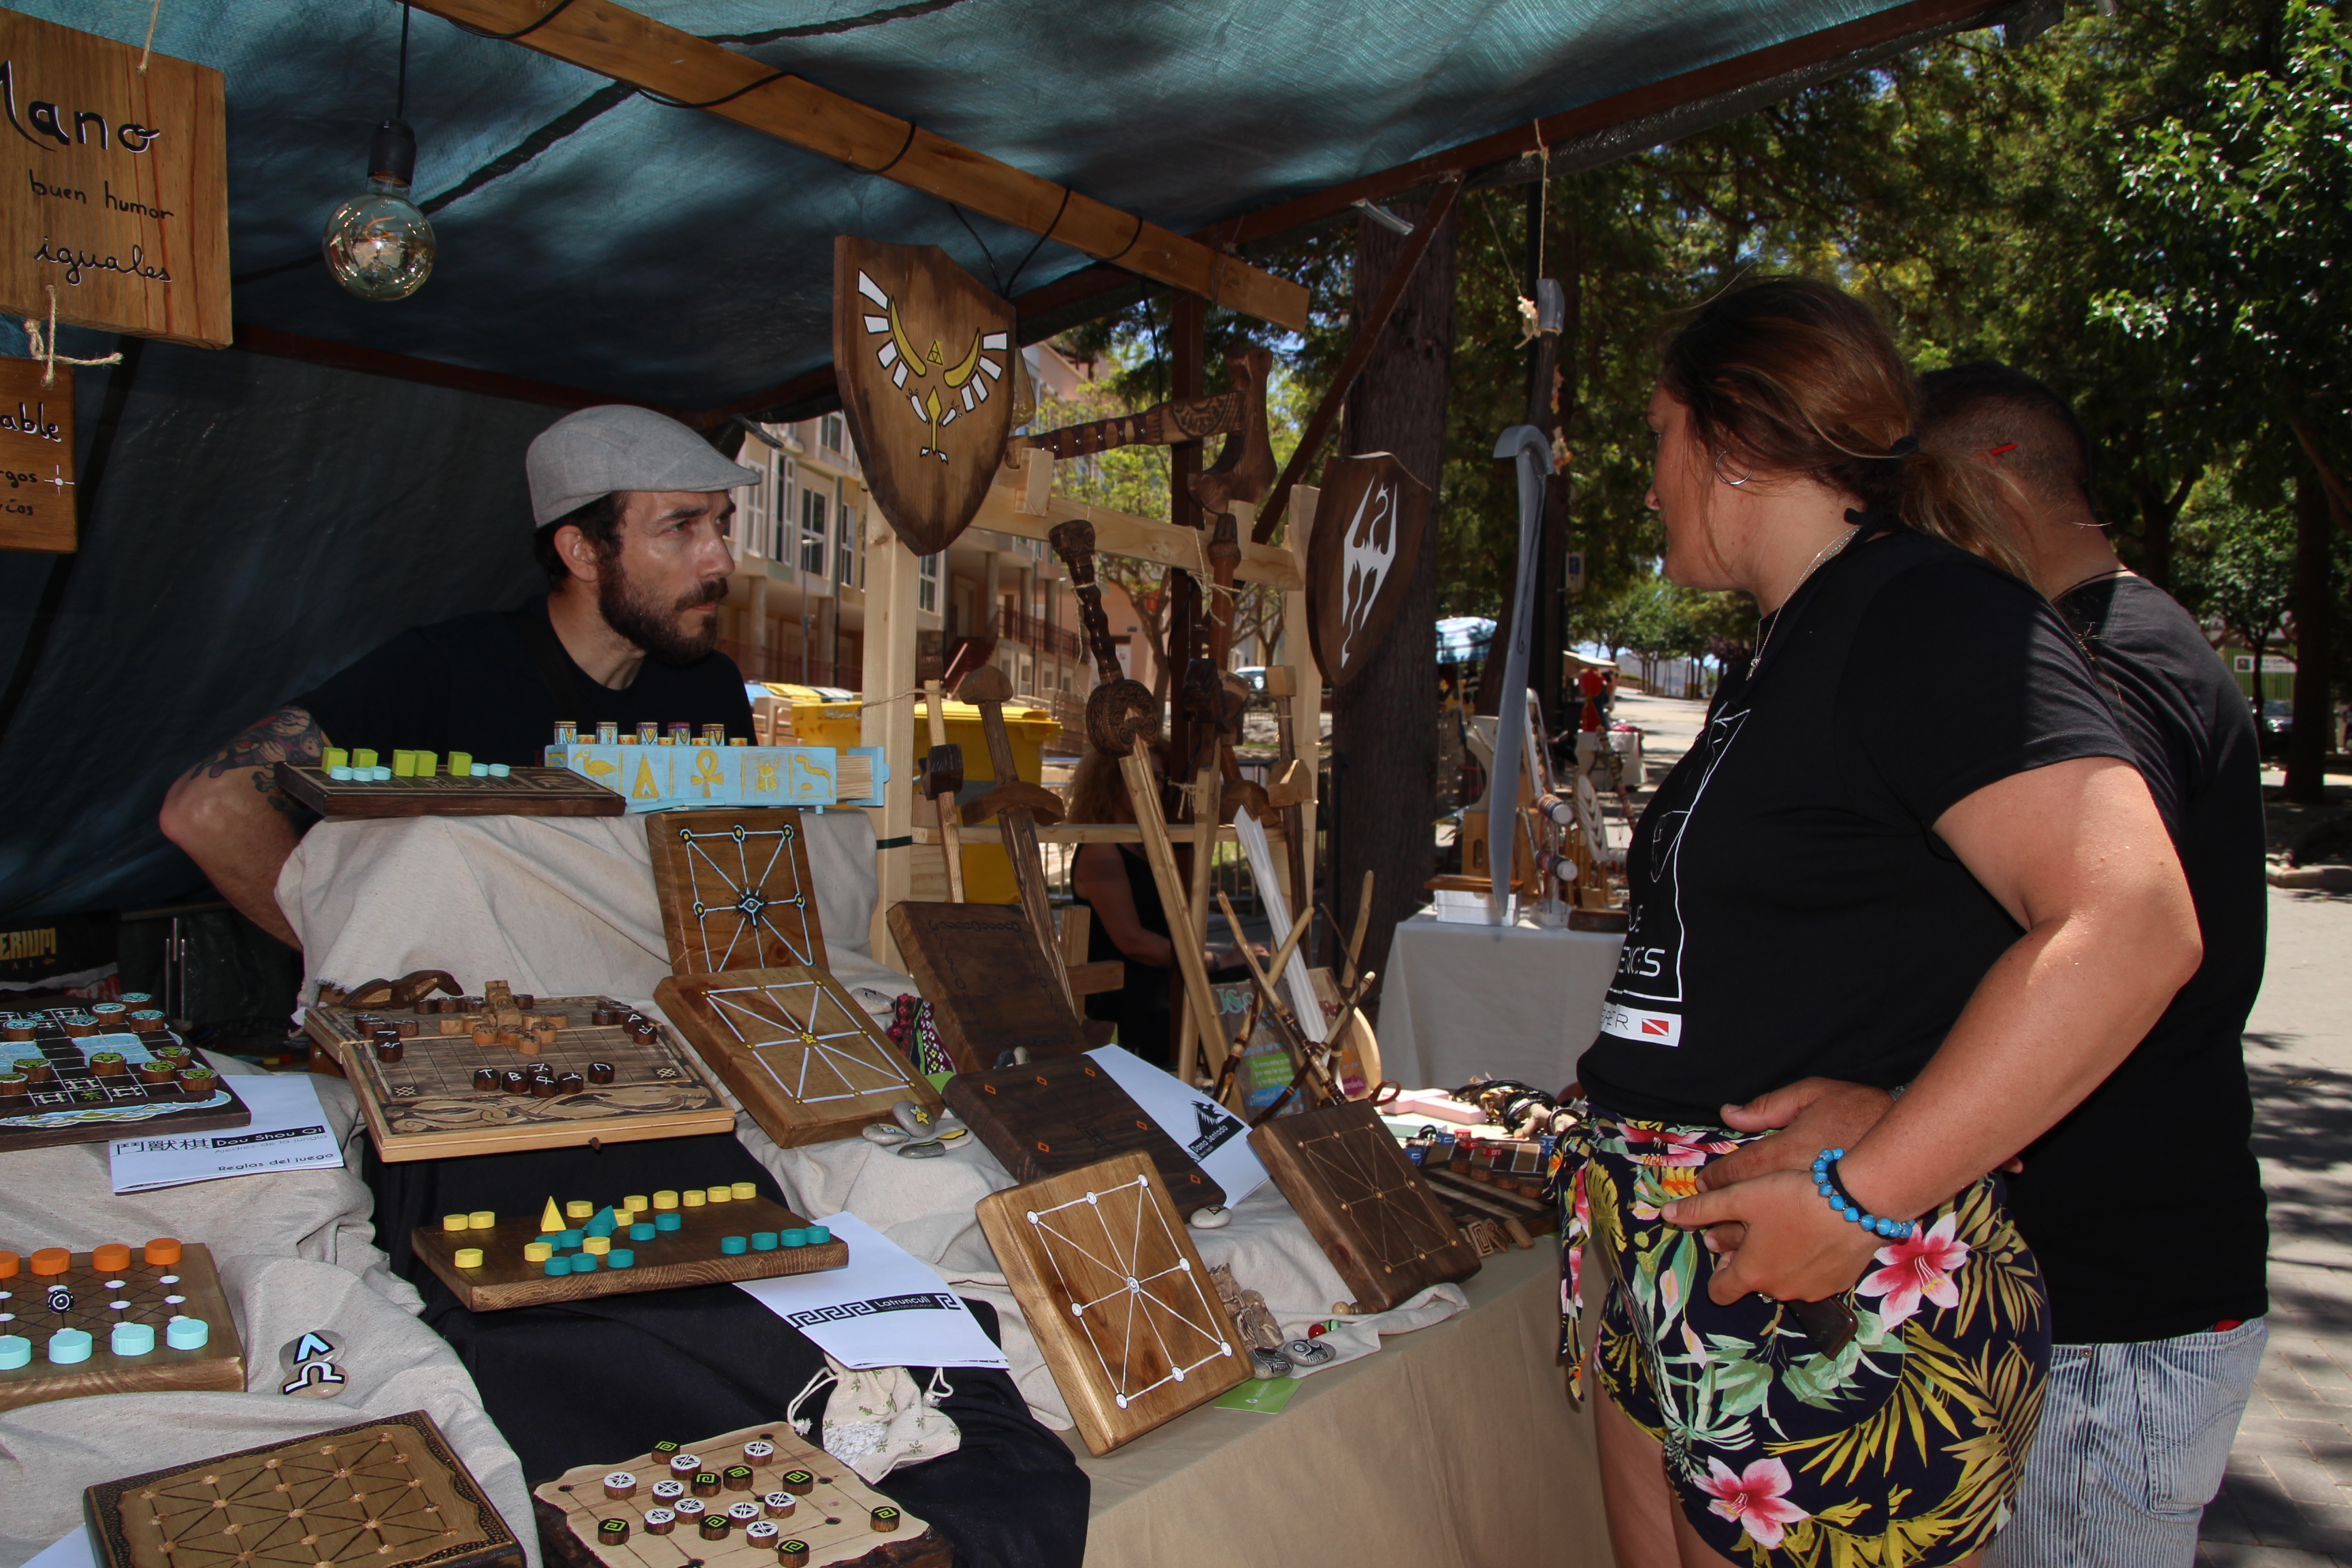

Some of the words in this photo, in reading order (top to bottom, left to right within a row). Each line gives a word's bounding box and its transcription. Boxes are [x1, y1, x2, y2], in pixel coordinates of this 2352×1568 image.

[29, 169, 87, 204] buen
[104, 180, 174, 219] humor
[34, 235, 172, 286] iguales
[0, 470, 38, 488] gos
[214, 1145, 255, 1154] Ajedrez
[294, 1134, 327, 1143] jungla
[216, 1138, 248, 1147] Dou
[255, 1132, 295, 1141] Shou
[1190, 1140, 1209, 1153] Dama
[1205, 1125, 1228, 1142] Sentada
[218, 1162, 264, 1171] Reglas
[295, 1153, 333, 1162] juego
[875, 1296, 931, 1307] Latrunculi
